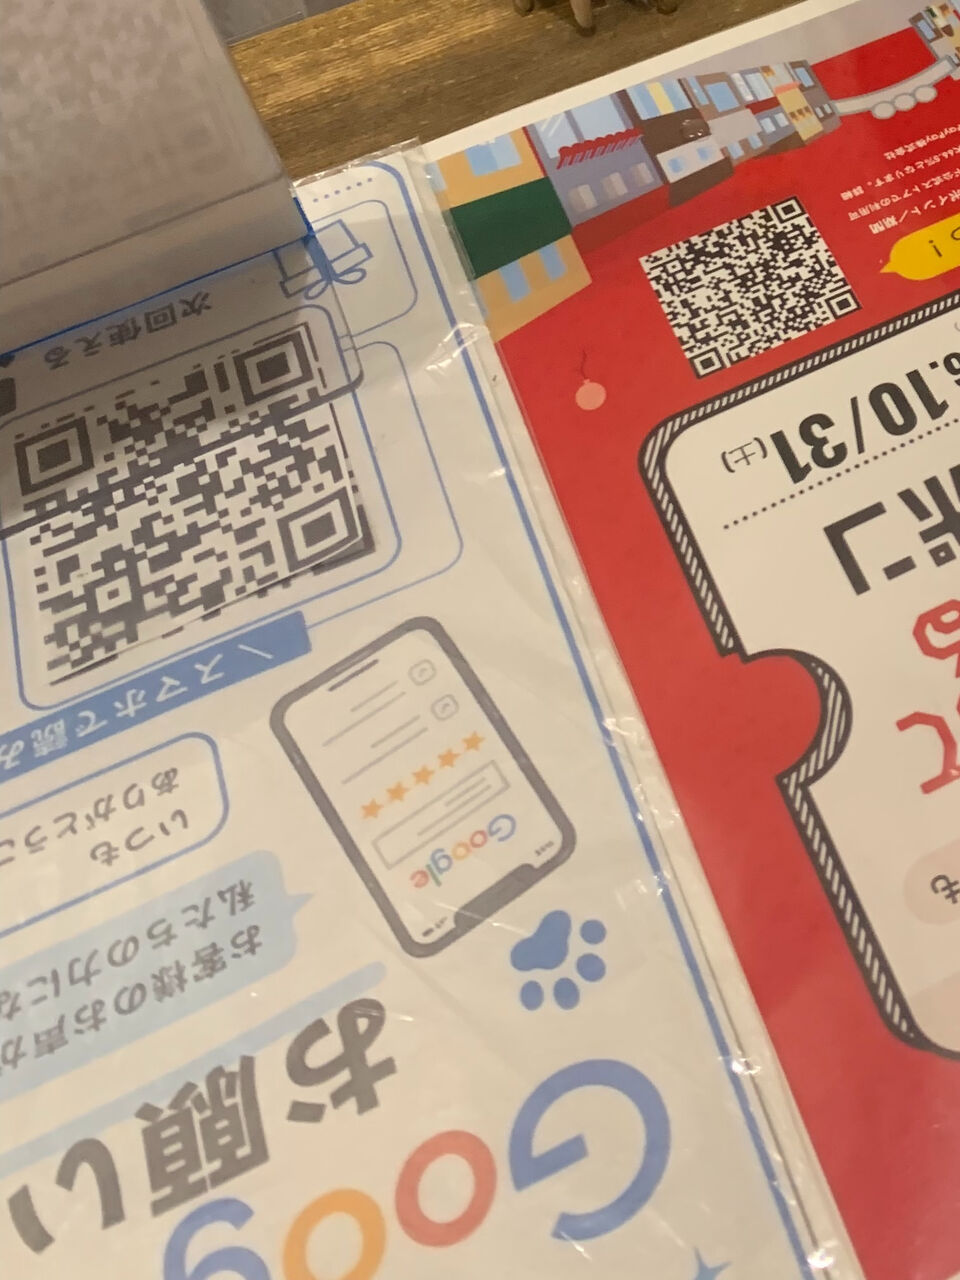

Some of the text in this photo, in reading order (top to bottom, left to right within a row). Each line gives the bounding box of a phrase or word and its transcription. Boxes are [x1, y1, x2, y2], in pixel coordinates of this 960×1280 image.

[44, 286, 216, 373] 次回使える
[89, 809, 189, 866] いつも
[400, 813, 517, 889] Google
[8, 998, 397, 1254] お願い
